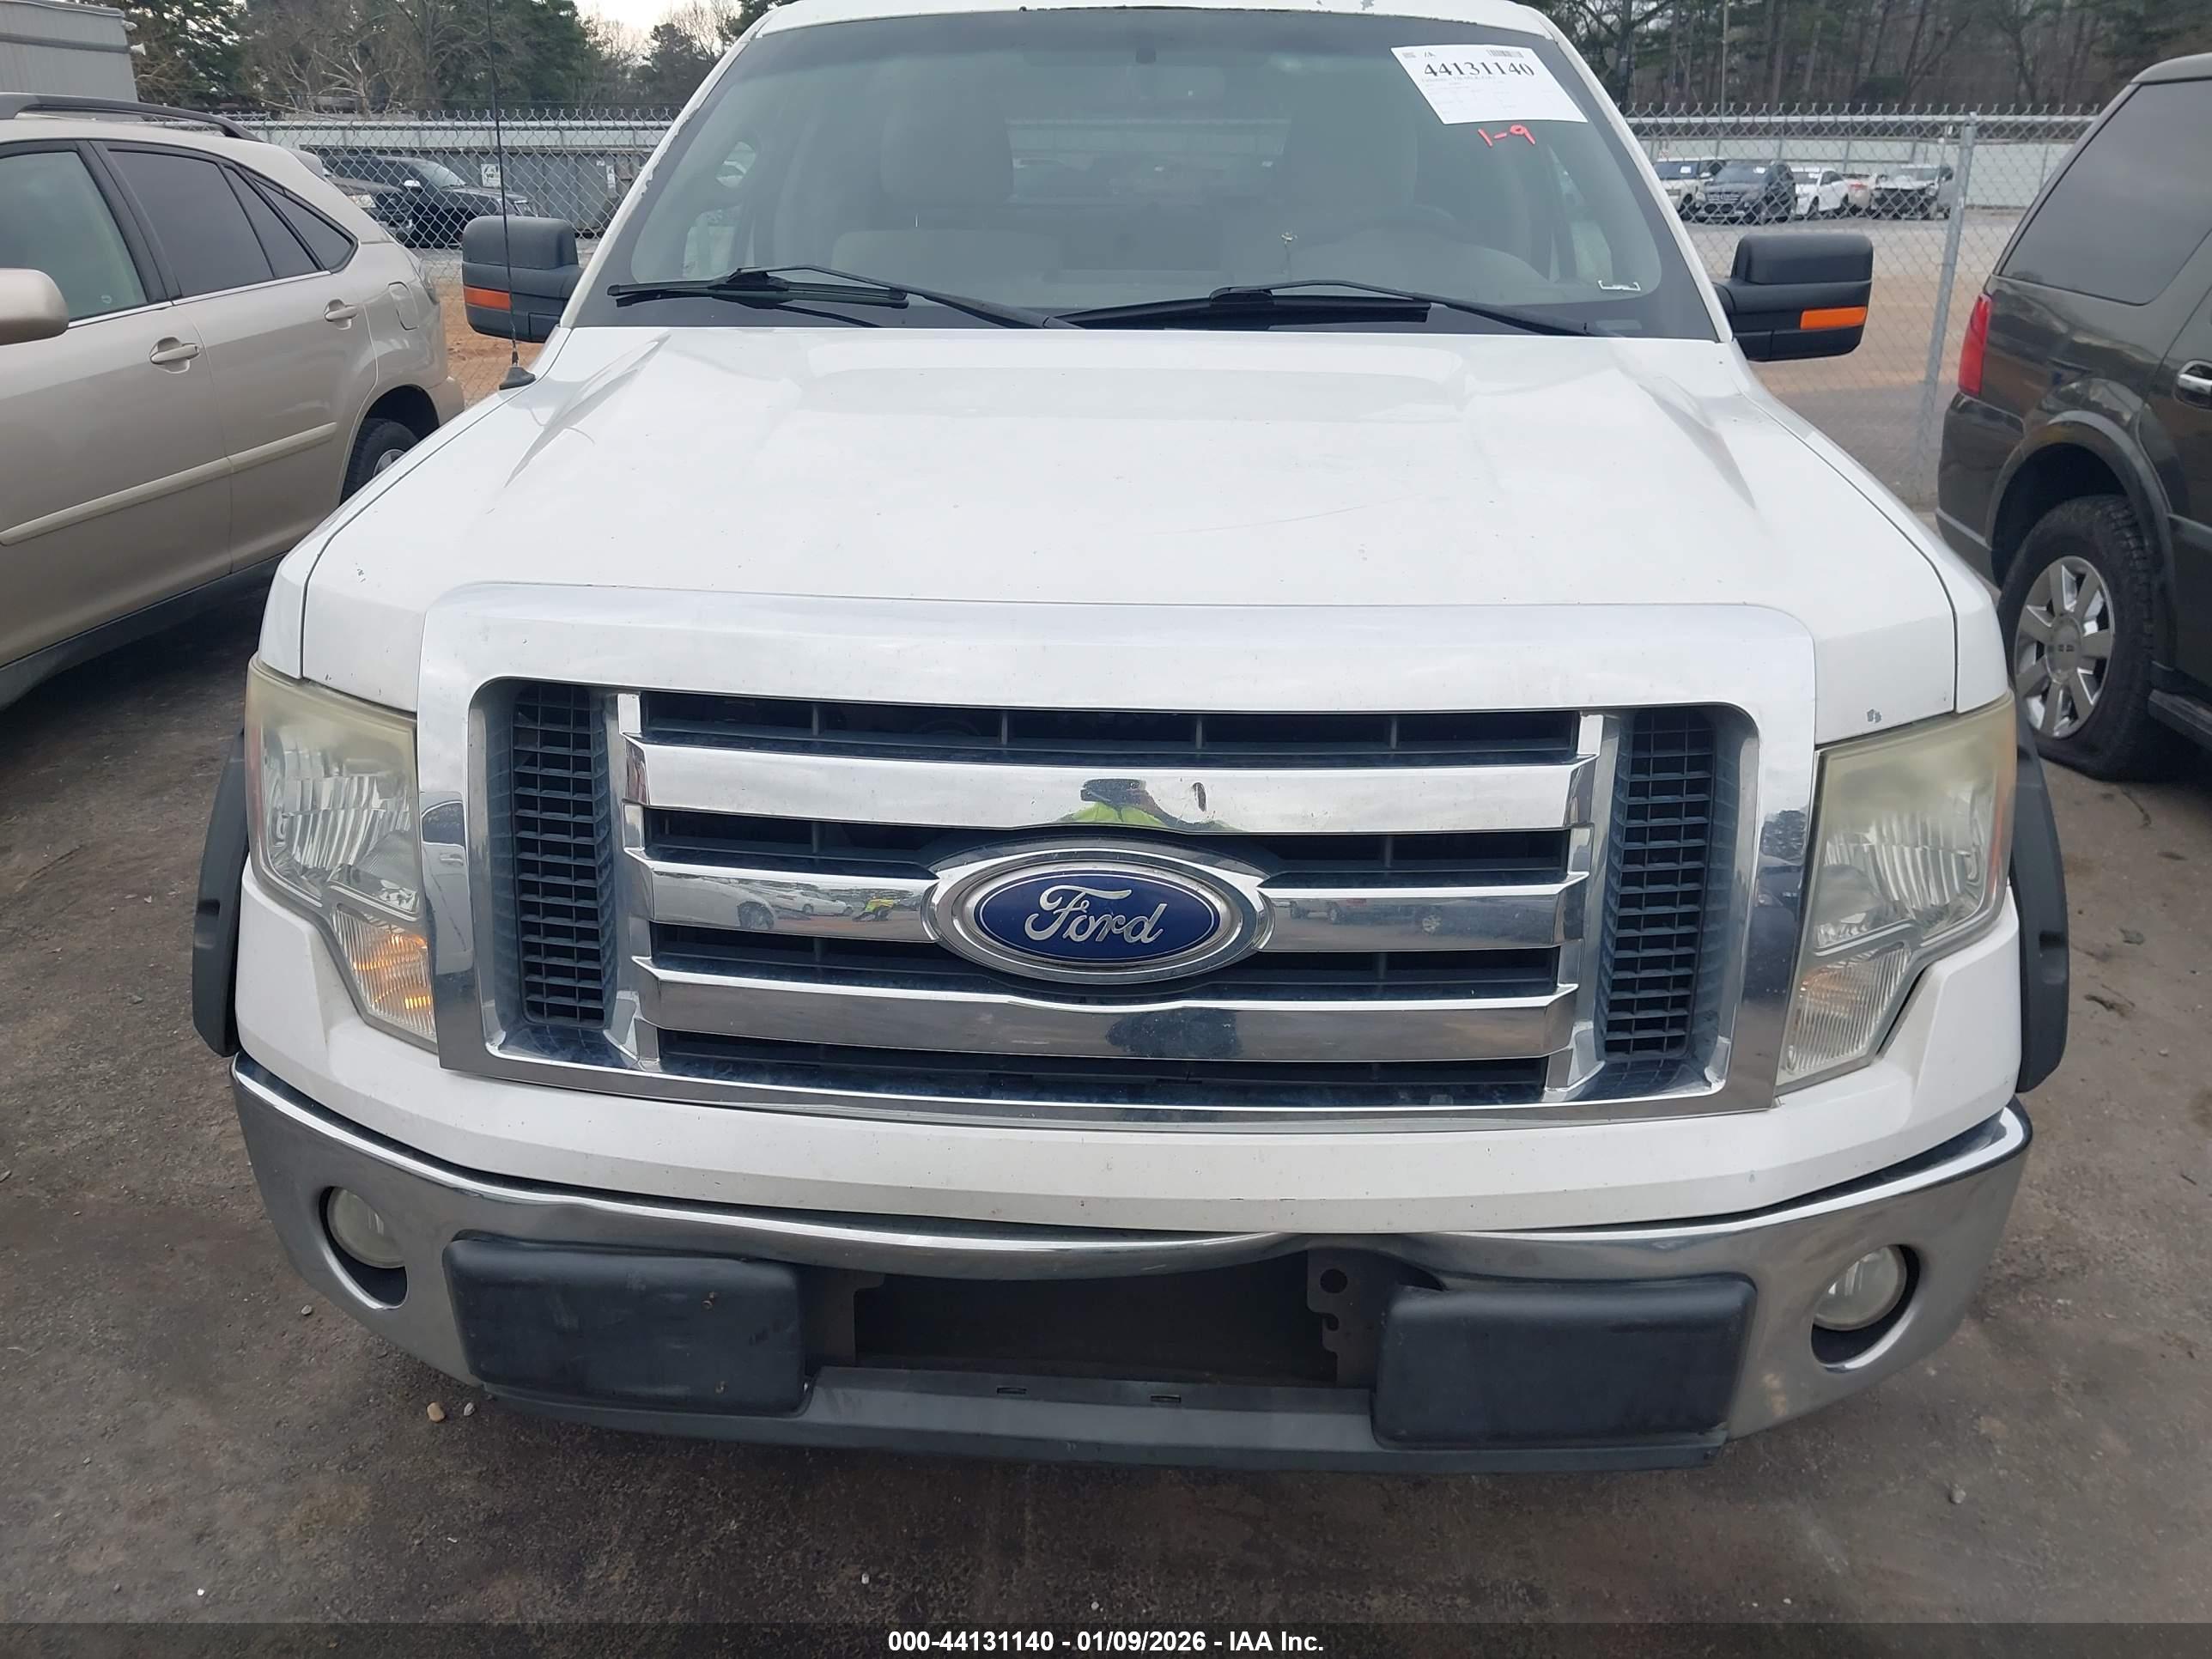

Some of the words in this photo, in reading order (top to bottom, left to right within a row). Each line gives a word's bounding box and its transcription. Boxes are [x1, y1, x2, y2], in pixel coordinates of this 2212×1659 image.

[1425, 62, 1534, 76] 44131140
[1478, 125, 1536, 148] 1-9
[1024, 884, 1167, 944] Ford
